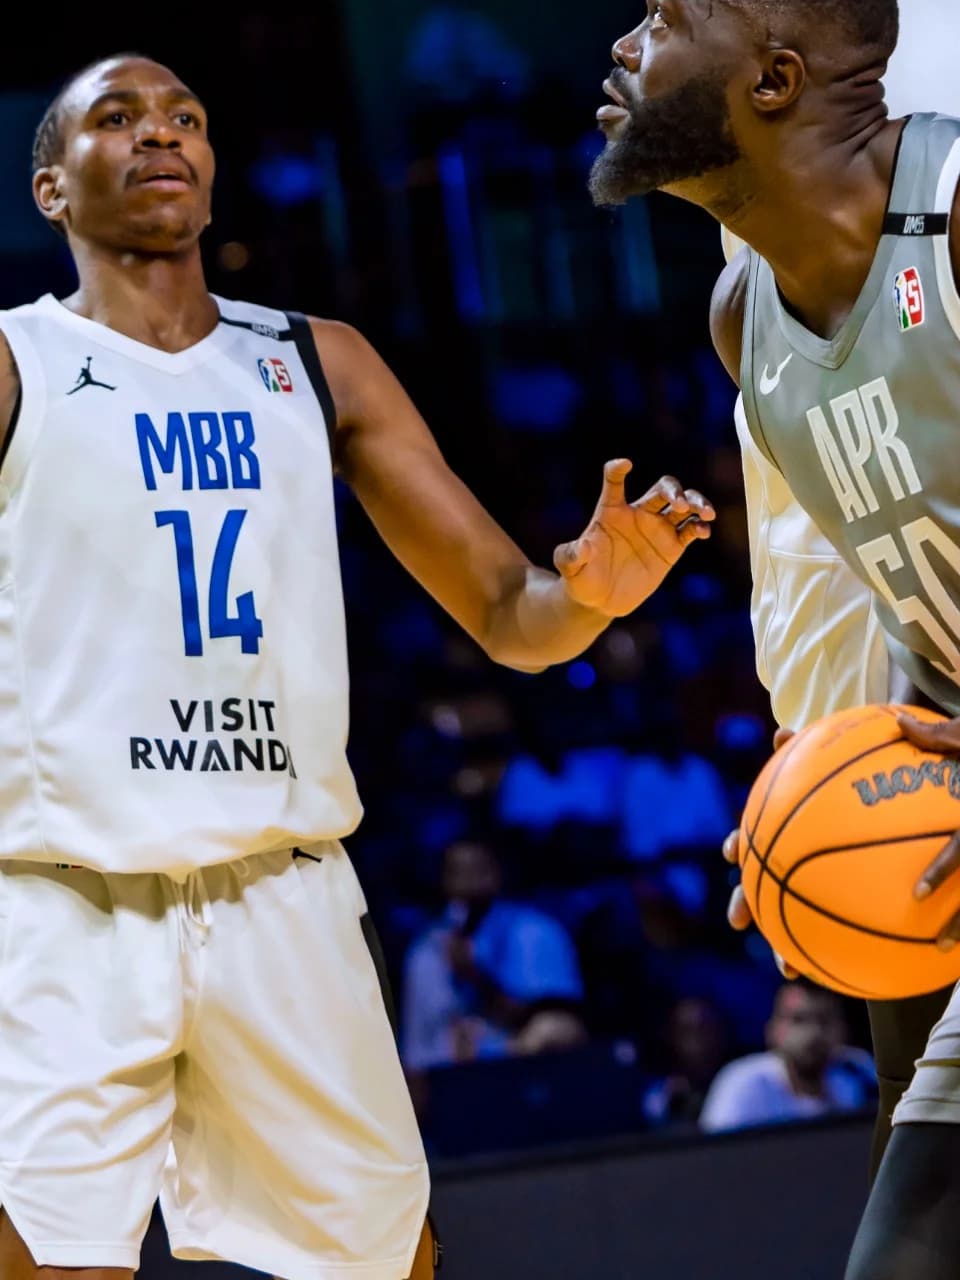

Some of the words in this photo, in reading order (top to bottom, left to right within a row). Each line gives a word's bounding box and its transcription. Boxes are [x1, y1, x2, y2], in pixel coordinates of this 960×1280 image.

[134, 411, 261, 491] MBB
[806, 376, 923, 523] APR
[154, 509, 263, 657] 14
[169, 698, 276, 733] VISIT
